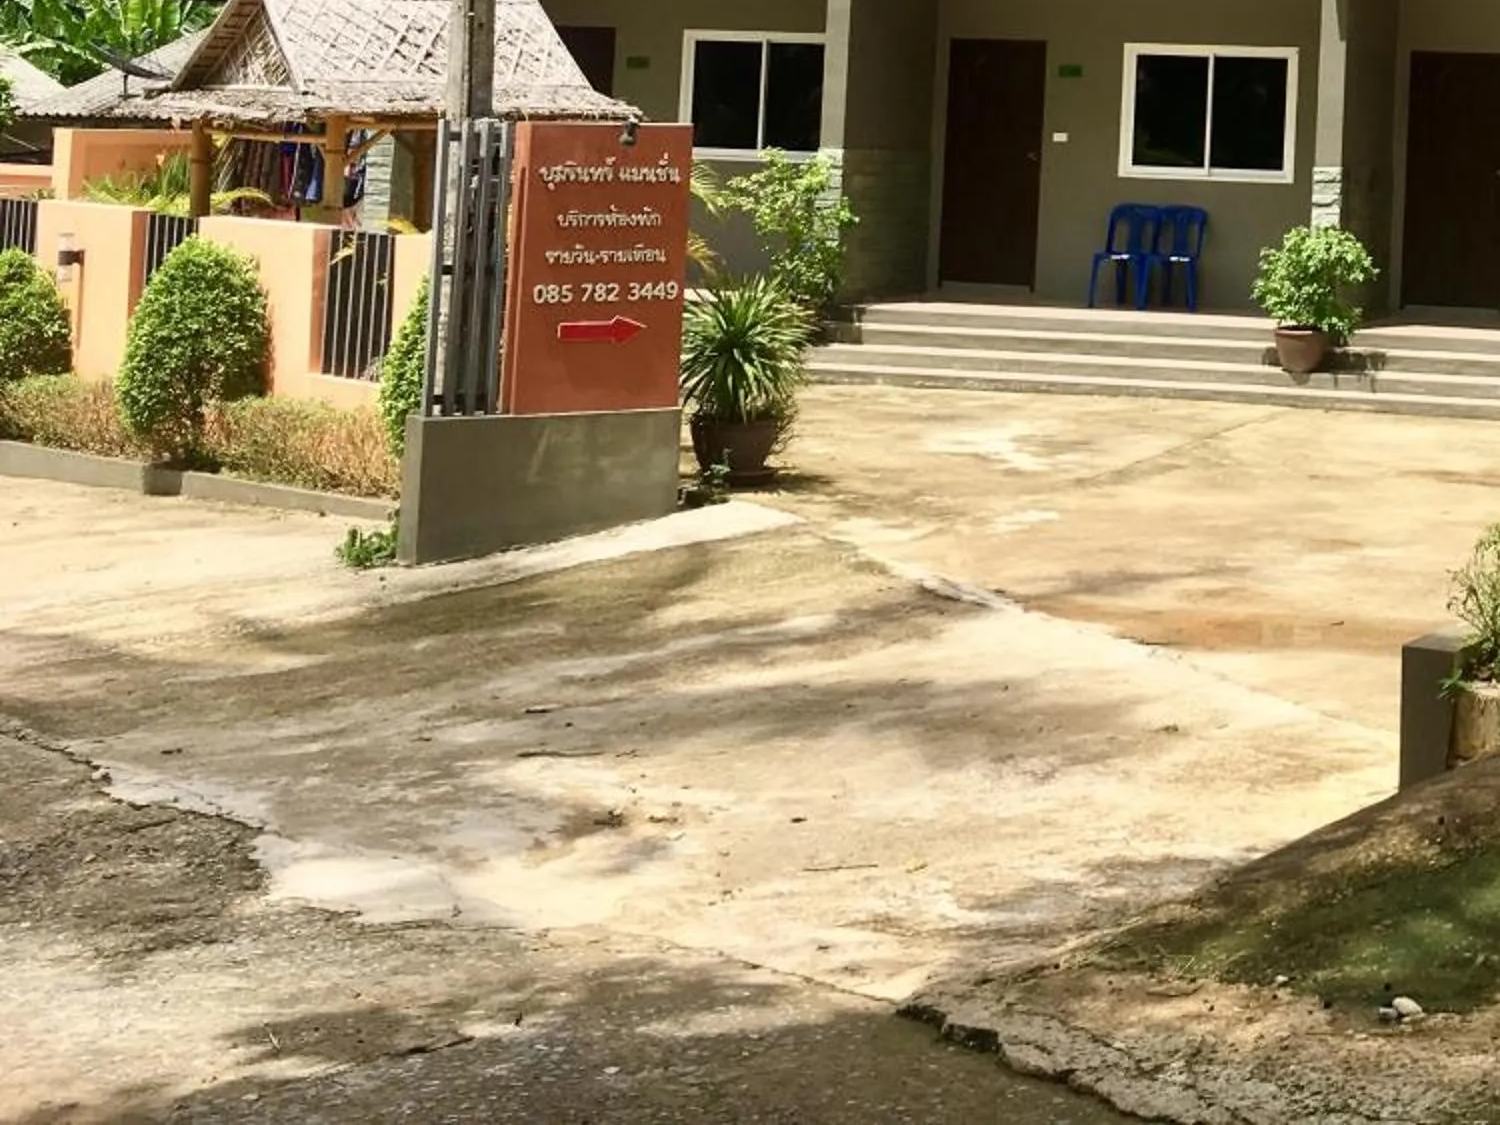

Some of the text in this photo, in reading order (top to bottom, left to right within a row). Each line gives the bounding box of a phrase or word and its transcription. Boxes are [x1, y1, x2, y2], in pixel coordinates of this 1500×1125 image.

[619, 152, 680, 183] แมนชั่น
[557, 204, 662, 228] บริการห้องพัก
[545, 243, 666, 265] รายวัน-รายเดือน
[533, 280, 679, 304] 085 782 3449
